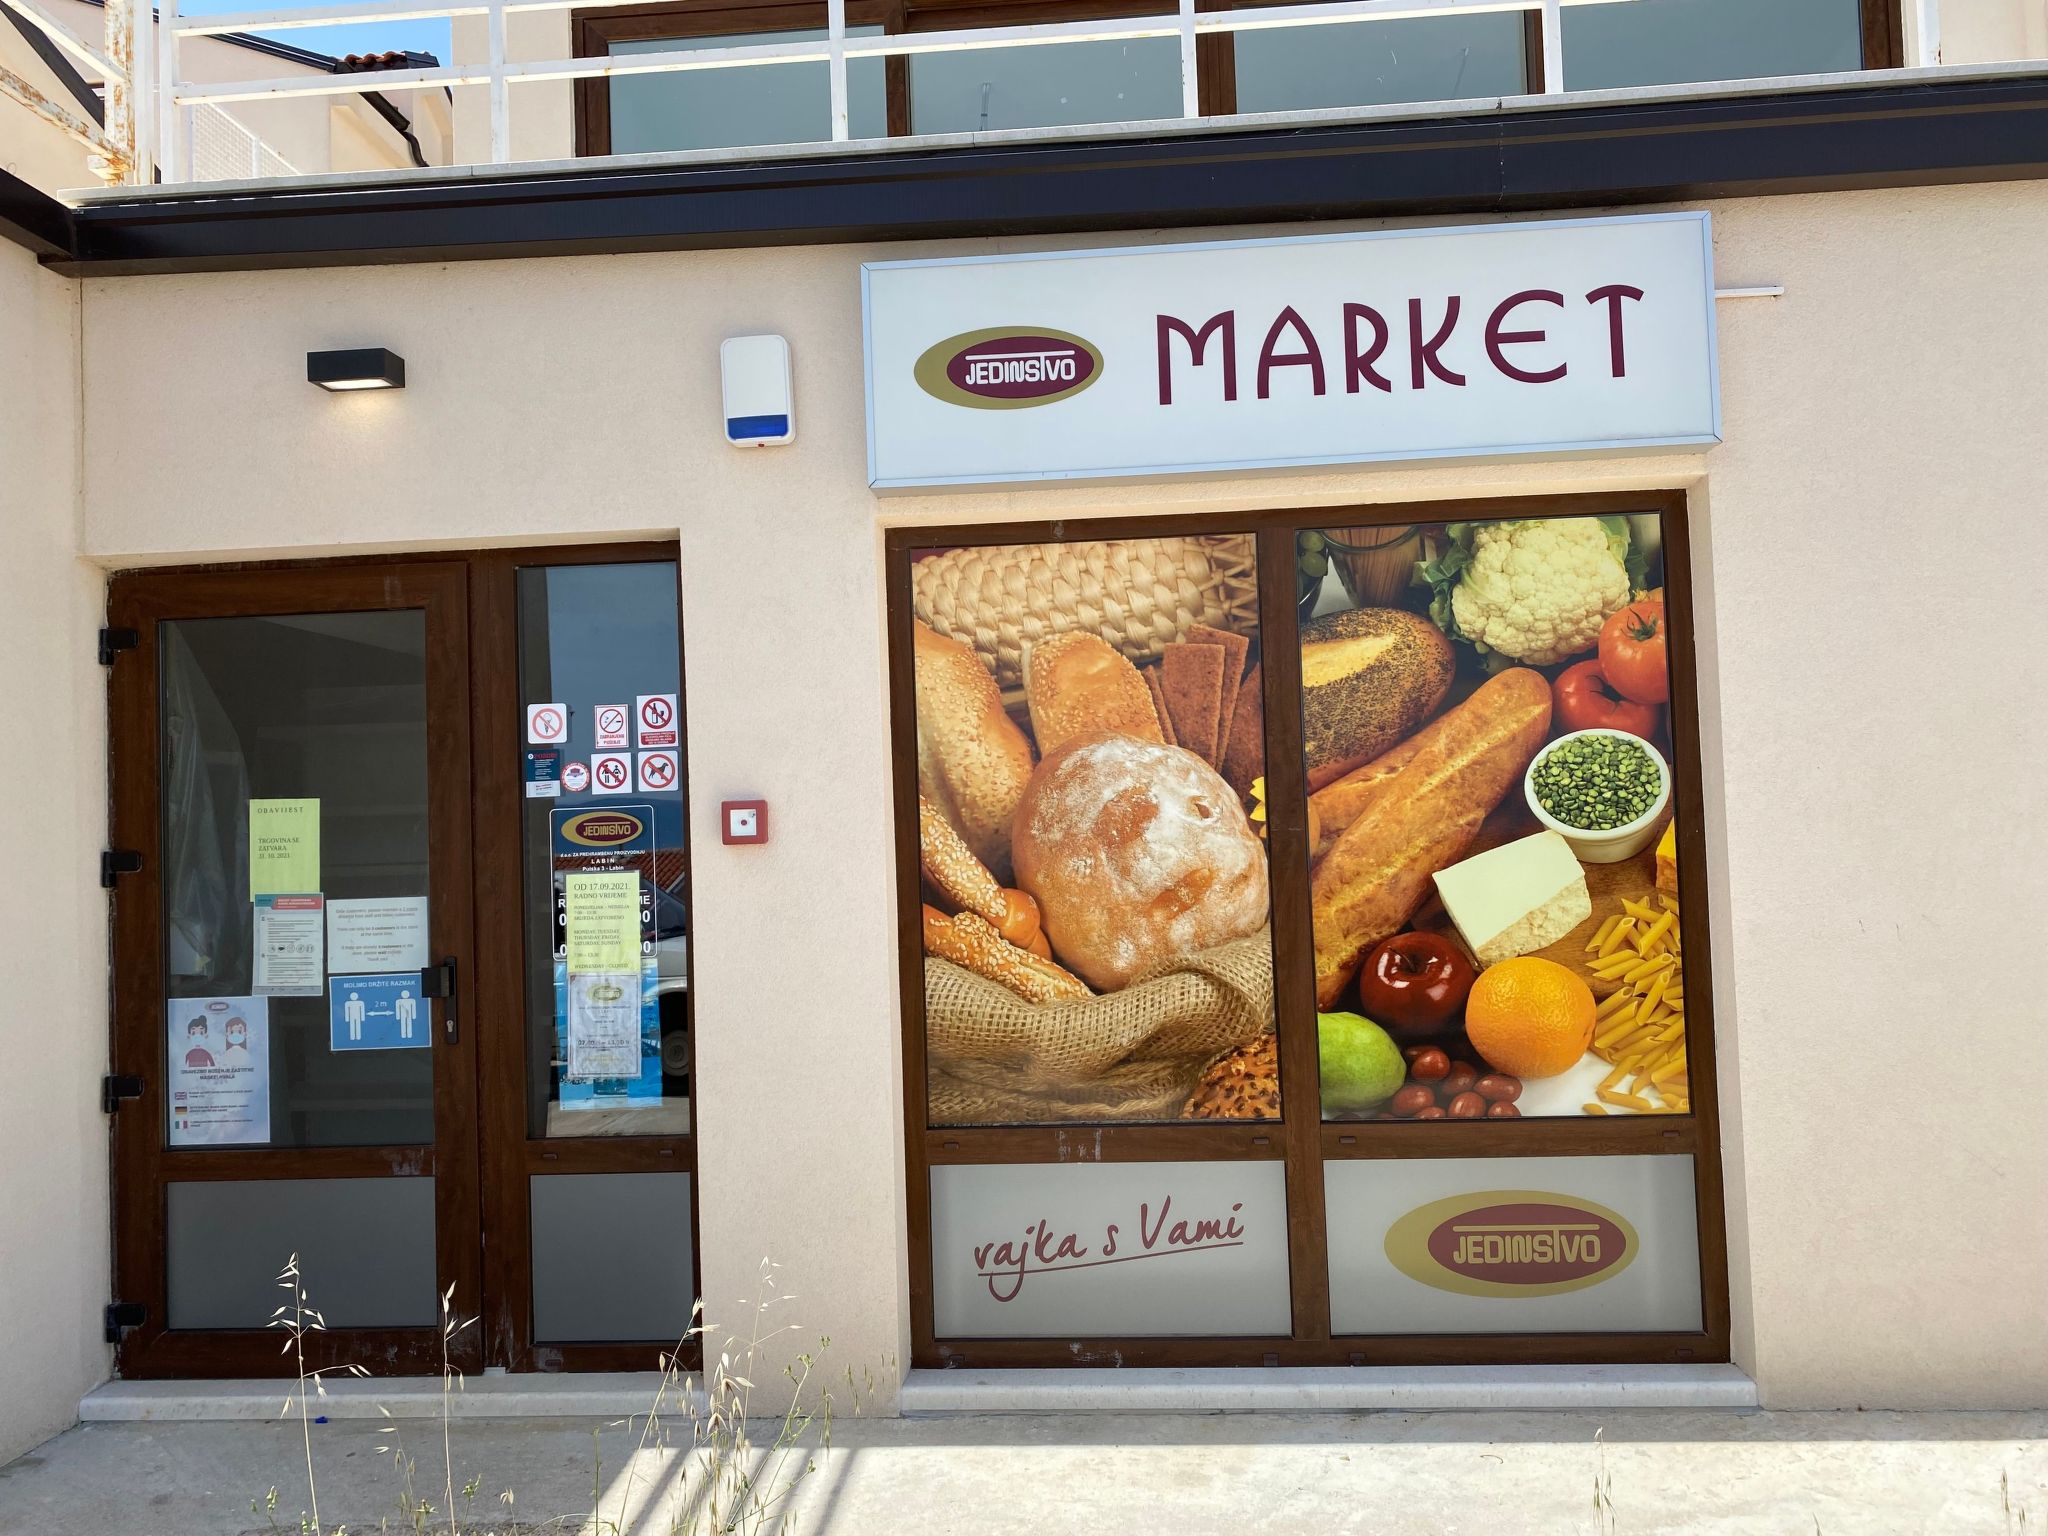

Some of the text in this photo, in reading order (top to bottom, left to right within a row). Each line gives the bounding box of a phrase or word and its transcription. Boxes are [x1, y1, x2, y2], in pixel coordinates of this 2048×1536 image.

[1156, 284, 1645, 406] MARKET
[965, 350, 1076, 385] JEDINSTVO
[583, 821, 631, 836] JEDINSTVO
[573, 882, 631, 891] OD 17.09.2021.
[974, 1195, 1245, 1303] rajka s Vami
[1453, 1224, 1601, 1265] JEDINSTVO
